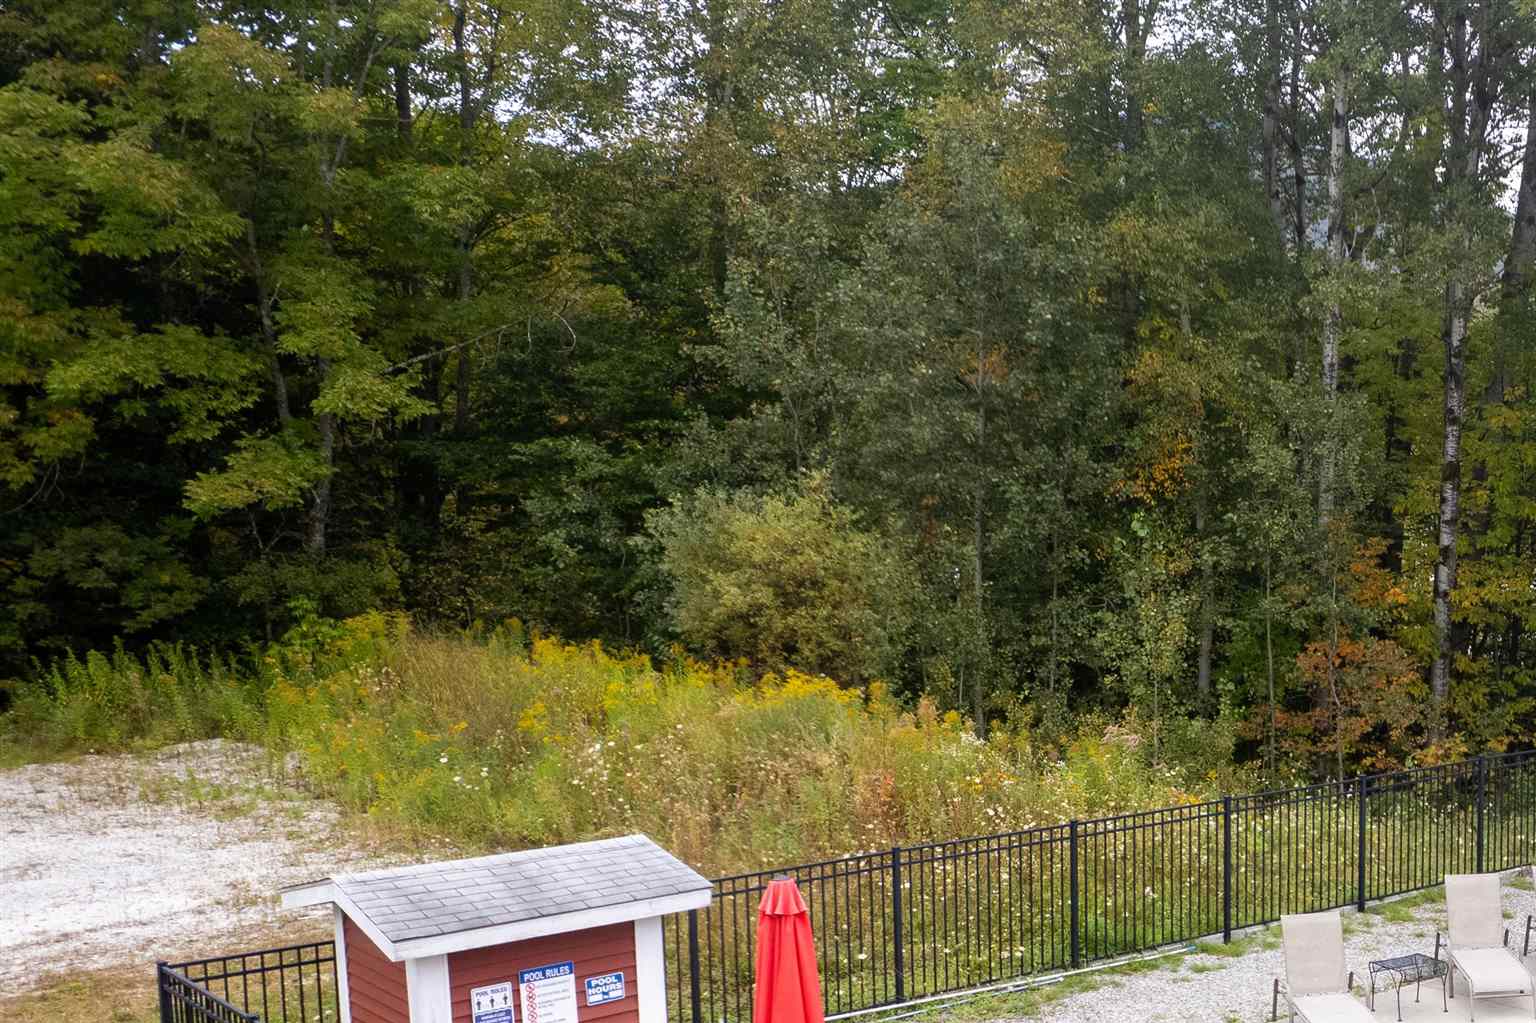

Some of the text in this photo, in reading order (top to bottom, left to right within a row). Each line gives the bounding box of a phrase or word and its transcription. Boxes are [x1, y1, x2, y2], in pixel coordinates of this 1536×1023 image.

[523, 966, 570, 982] POOL RULES
[591, 976, 618, 987] POOL
[588, 983, 622, 996] HOURS
